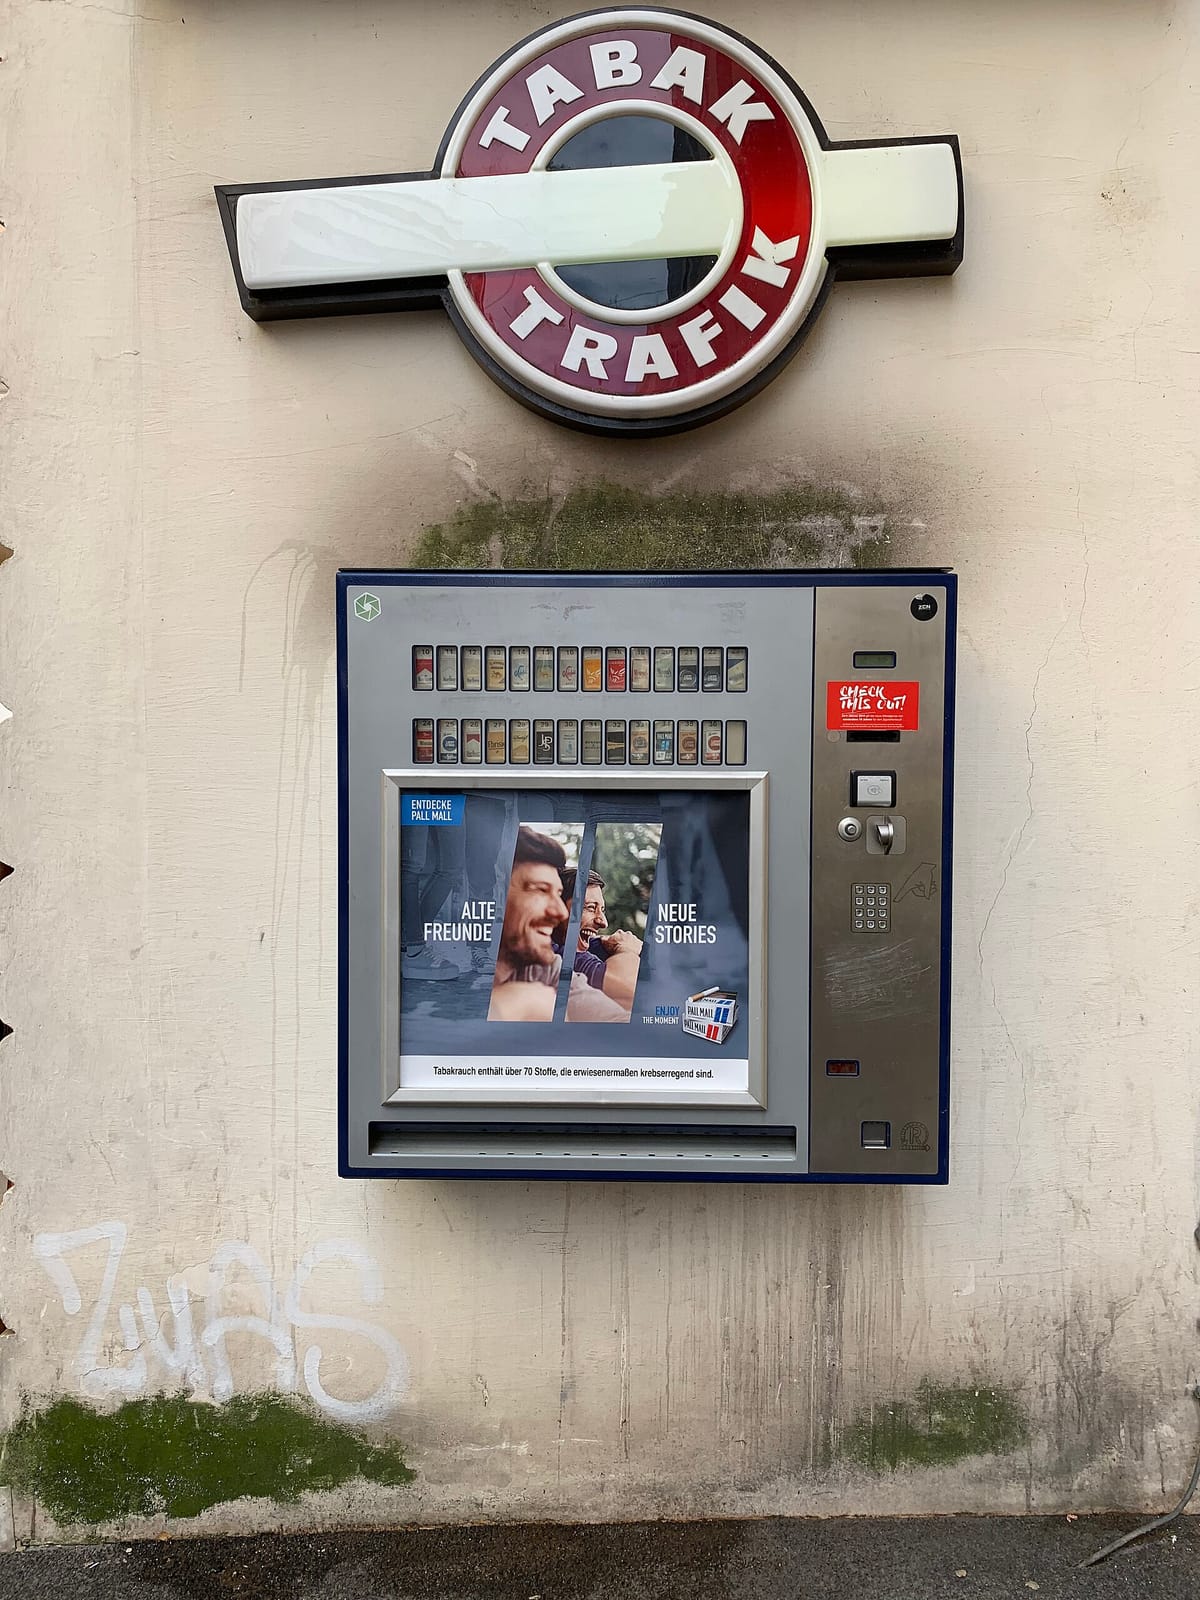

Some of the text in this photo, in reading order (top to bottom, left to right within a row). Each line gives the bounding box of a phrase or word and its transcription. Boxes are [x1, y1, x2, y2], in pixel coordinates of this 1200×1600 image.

[479, 39, 775, 151] TABAK
[508, 225, 799, 382] TRAFIK
[840, 685, 886, 698] CHECK
[840, 696, 871, 711] THIS
[411, 799, 452, 810] ENTDECKE
[411, 811, 452, 821] PALL MALL
[461, 901, 496, 920] ALTE
[658, 903, 697, 922] NEUE
[424, 922, 492, 942] FREUNDE
[655, 925, 716, 944] STORIES
[655, 1006, 680, 1016] ENJOY
[700, 1007, 714, 1018] MALL
[642, 1016, 679, 1025] THE MOMENT
[433, 1066, 714, 1080] Tabakrauch enthält über 70 Stoffe, die erwiesenermaßen krebserregend sind.
